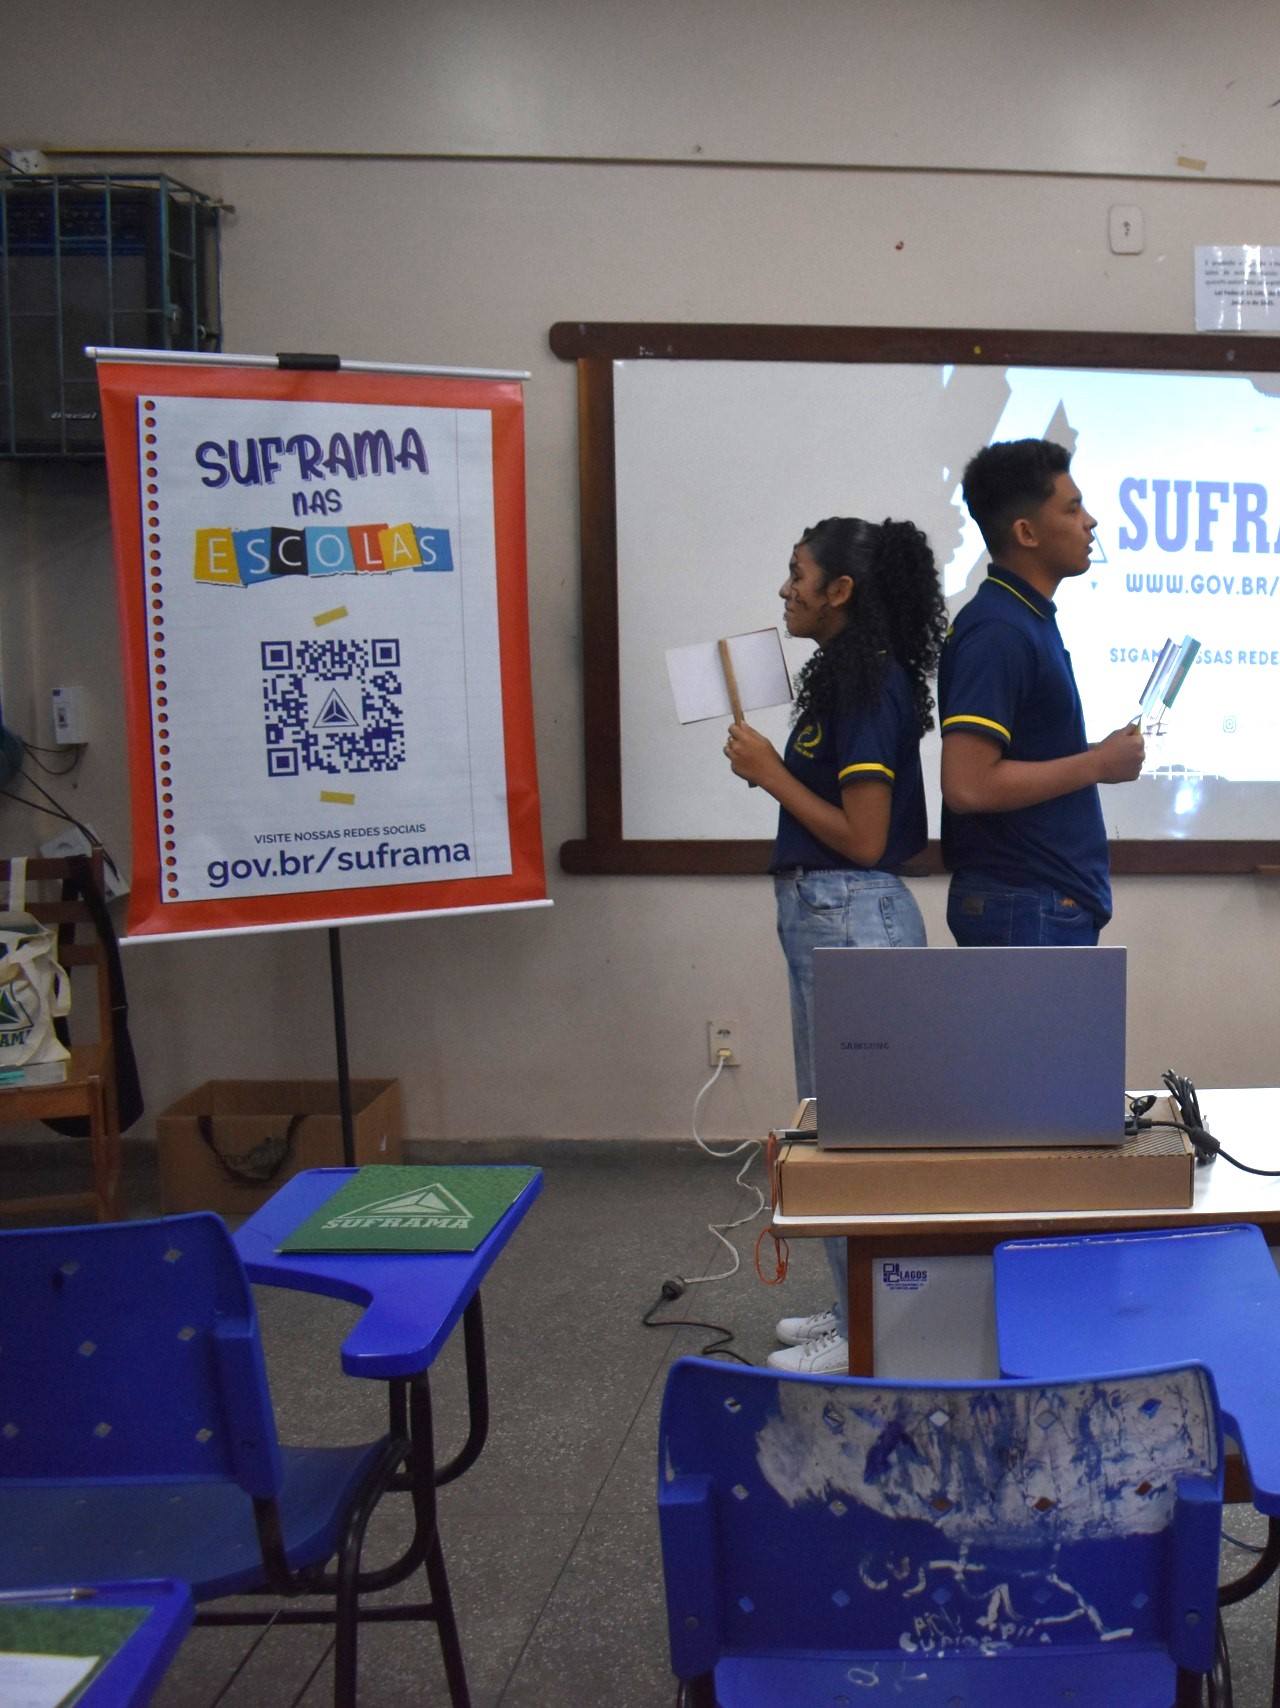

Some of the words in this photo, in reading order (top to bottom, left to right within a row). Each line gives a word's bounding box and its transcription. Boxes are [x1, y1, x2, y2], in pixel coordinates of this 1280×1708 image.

[195, 427, 429, 488] SUFRAMA
[208, 532, 438, 575] ESCOLAS
[254, 832, 292, 844] VISITE
[294, 829, 341, 841] NOSSAS
[343, 826, 380, 839] REDES
[383, 823, 426, 836] SOCIAIS
[207, 841, 471, 888] gov.br/suframa
[321, 1217, 470, 1230] SUFRAMA
